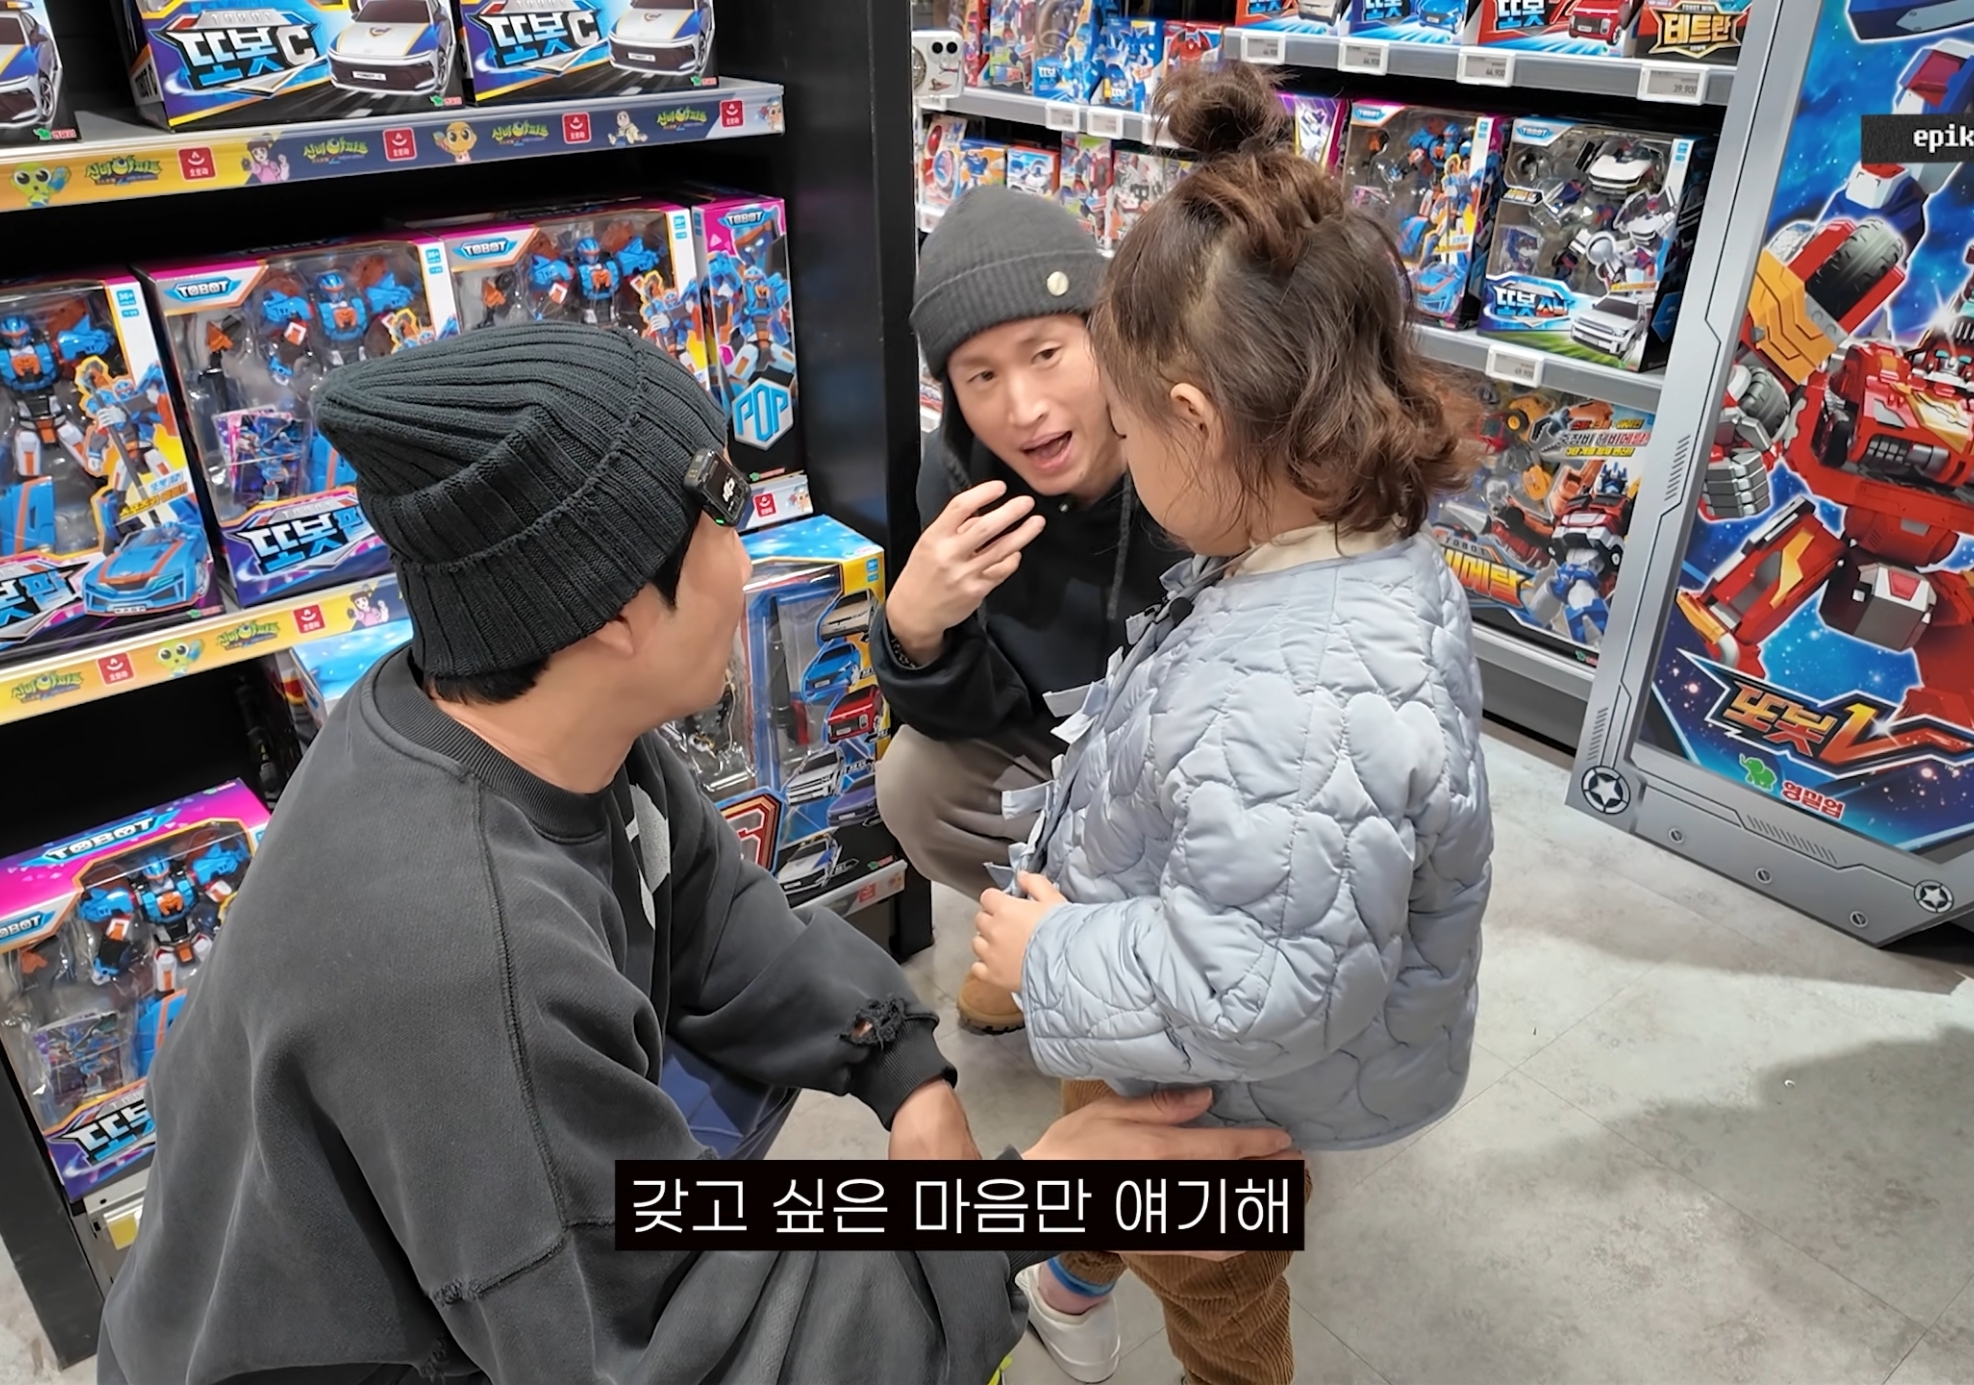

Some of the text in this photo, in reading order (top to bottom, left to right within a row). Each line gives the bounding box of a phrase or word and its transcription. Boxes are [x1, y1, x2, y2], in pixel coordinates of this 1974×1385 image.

[727, 213, 764, 225] TOBOT
[464, 240, 508, 256] TOBOT
[178, 280, 229, 298] TOBOT
[736, 384, 789, 442] POP
[1445, 536, 1487, 556] TOBOT
[49, 817, 154, 860] TOBOT
[0, 914, 41, 938] OBOT
